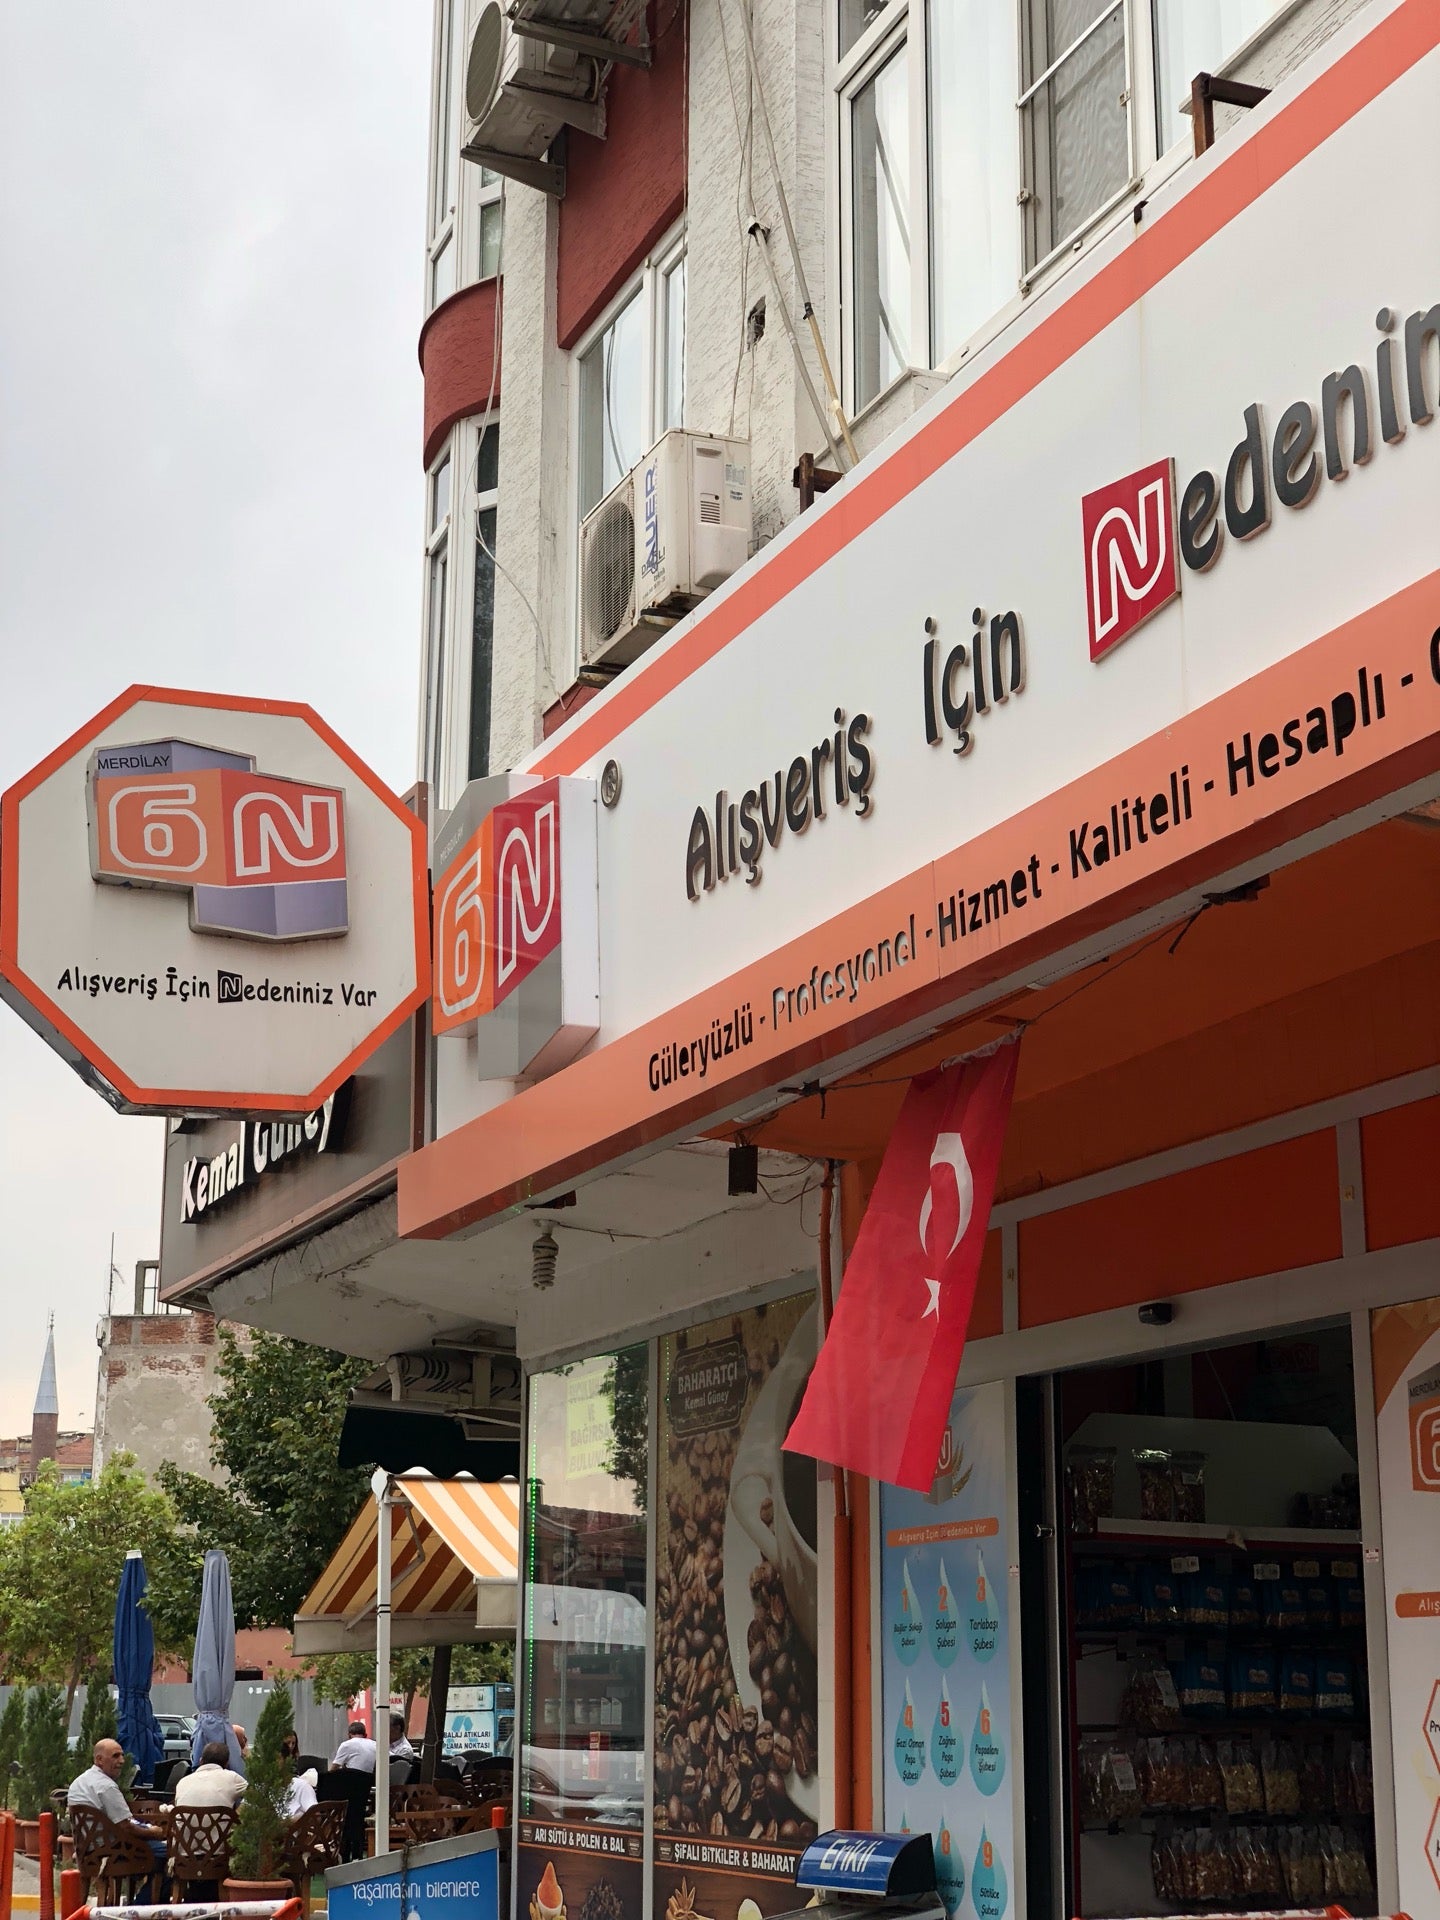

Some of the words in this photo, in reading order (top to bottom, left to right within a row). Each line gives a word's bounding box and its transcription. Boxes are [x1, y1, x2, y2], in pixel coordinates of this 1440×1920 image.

[97, 754, 171, 771] MERDİLAY
[686, 706, 875, 902] Alışveriş
[924, 607, 1027, 755] İçin
[648, 1003, 754, 1092] Güleryüzlü
[772, 914, 917, 1031] Profesyonel
[938, 854, 1042, 948] Hizmet
[1070, 765, 1193, 880] Kaliteli
[1226, 667, 1386, 797] Hesaplı
[57, 966, 158, 1001] Alışveriş
[165, 967, 211, 1001] İçin
[217, 969, 334, 1005] Nedeniniz
[341, 983, 377, 1006] Var
[180, 1121, 246, 1224] Kemal
[678, 1361, 738, 1394] BAHARATÇI
[902, 1588, 908, 1613] 1
[938, 1585, 948, 1612] 2
[976, 1575, 986, 1602] 3
[937, 1637, 956, 1650] Şubesi
[973, 1638, 995, 1652] Şubesi
[904, 1705, 913, 1730] 4
[941, 1701, 950, 1727] 5
[981, 1708, 990, 1735] 6
[464, 1742, 491, 1750] NOKTASI
[534, 1828, 547, 1842] ARI
[547, 1828, 568, 1845] SÜTÜ
[568, 1832, 575, 1846] &
[576, 1833, 601, 1850] POLEN
[602, 1836, 609, 1851] &
[609, 1837, 625, 1854] BAL
[942, 1829, 950, 1856] 8
[983, 1841, 992, 1868] 9
[742, 1852, 750, 1868] &
[751, 1852, 796, 1874] BAHARAT
[820, 1839, 883, 1873] Erikli
[426, 1880, 481, 1898] bilenlere
